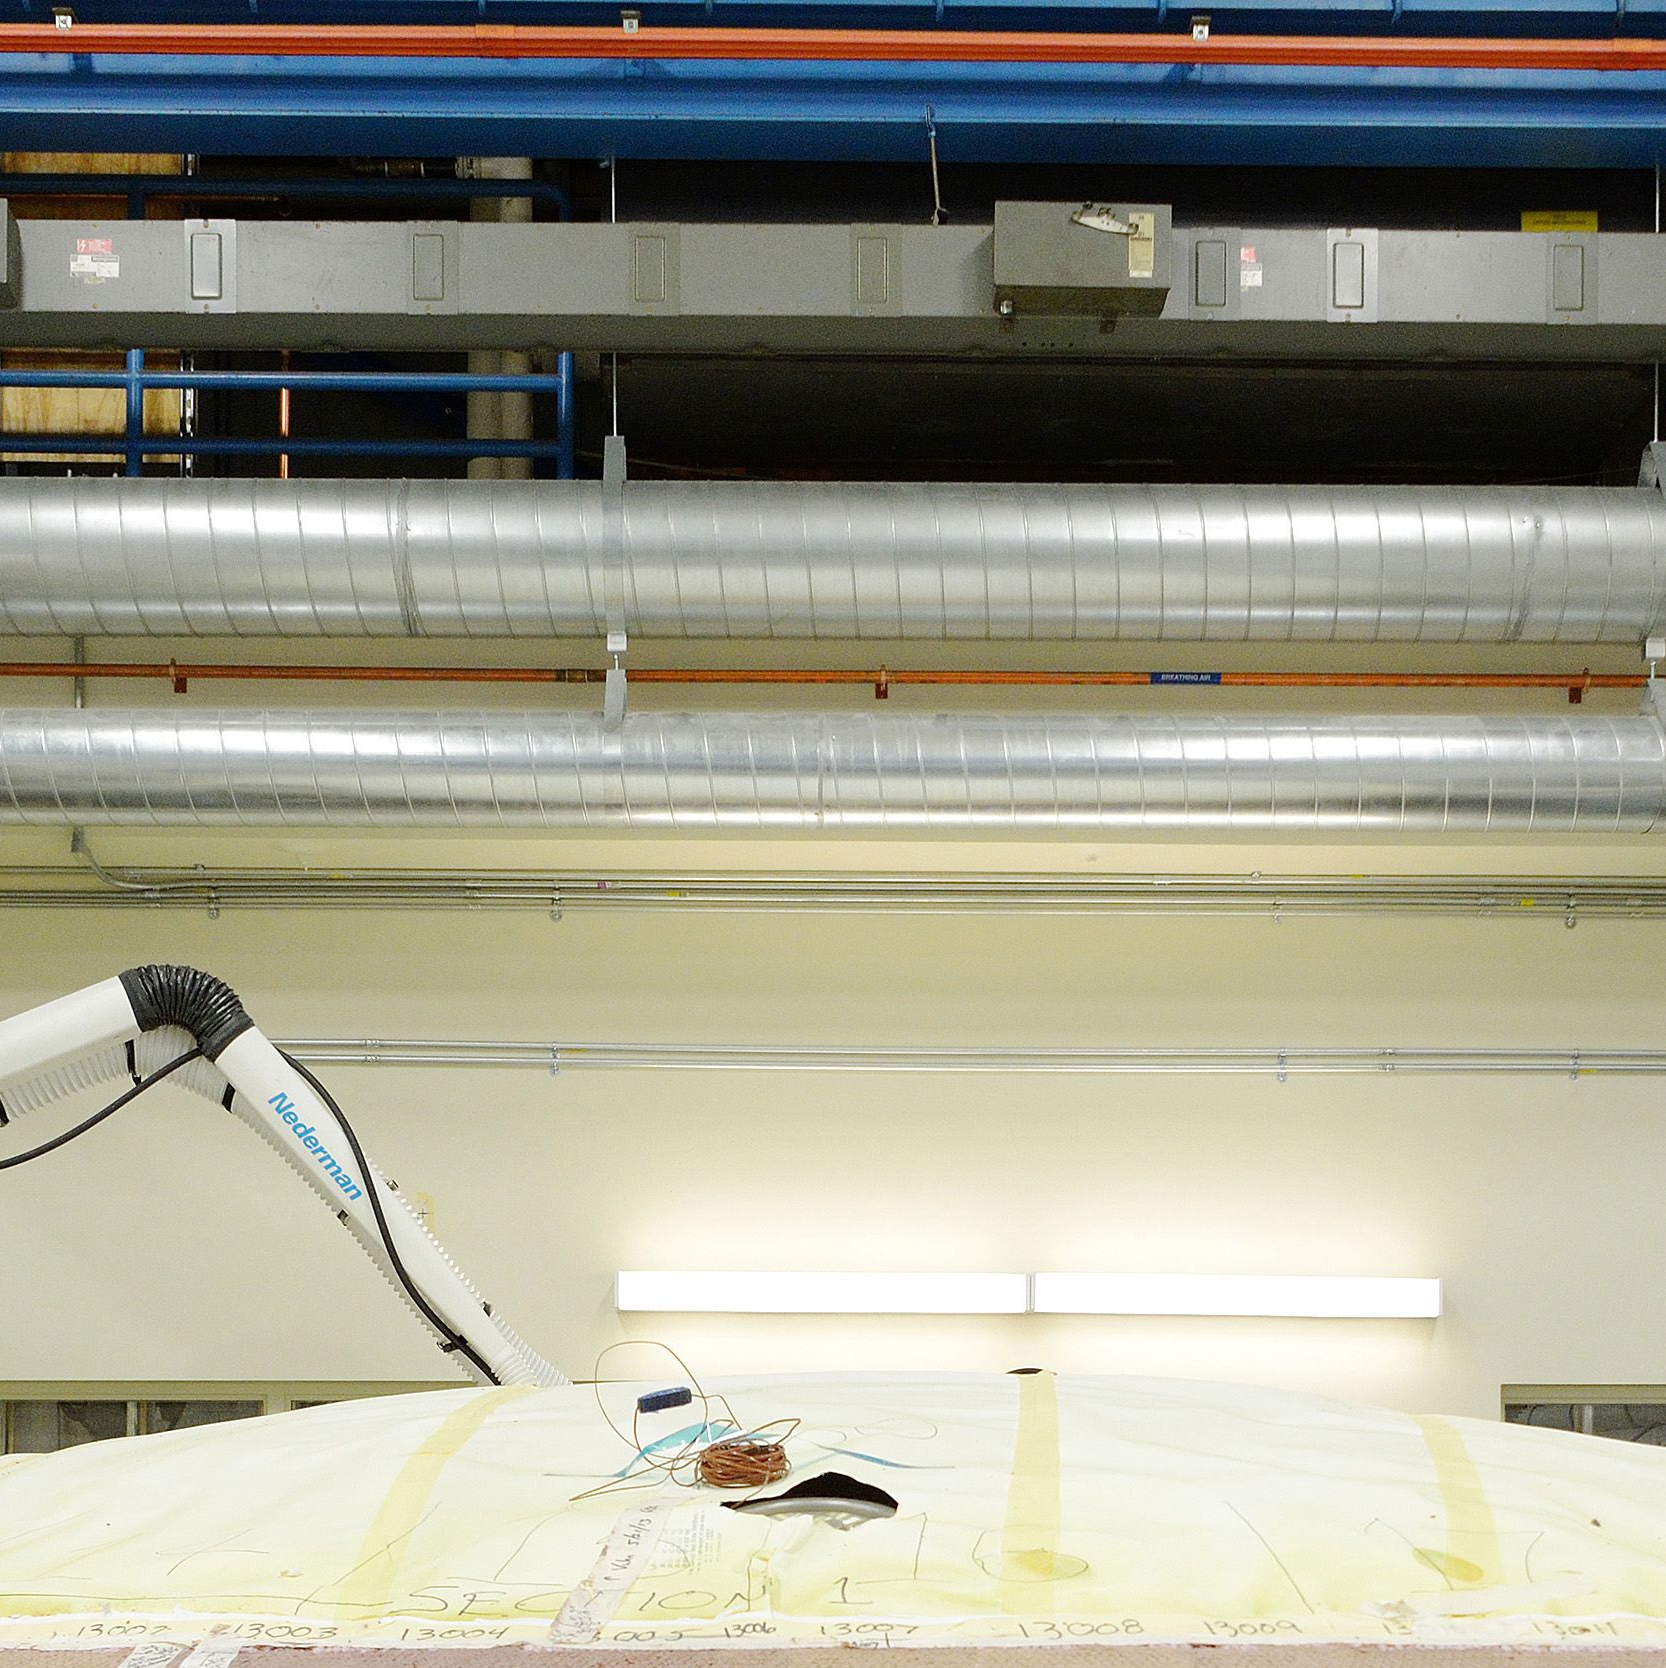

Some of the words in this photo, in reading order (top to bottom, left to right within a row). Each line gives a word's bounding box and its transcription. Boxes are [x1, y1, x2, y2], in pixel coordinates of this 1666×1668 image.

[268, 1091, 364, 1202] Nederman
[391, 1585, 767, 1613] SECION
[234, 1622, 339, 1639] 13003
[401, 1625, 511, 1640] 13004
[820, 1623, 919, 1636] 13007
[1020, 1618, 1144, 1638] 13008
[1203, 1619, 1303, 1636] 13009
